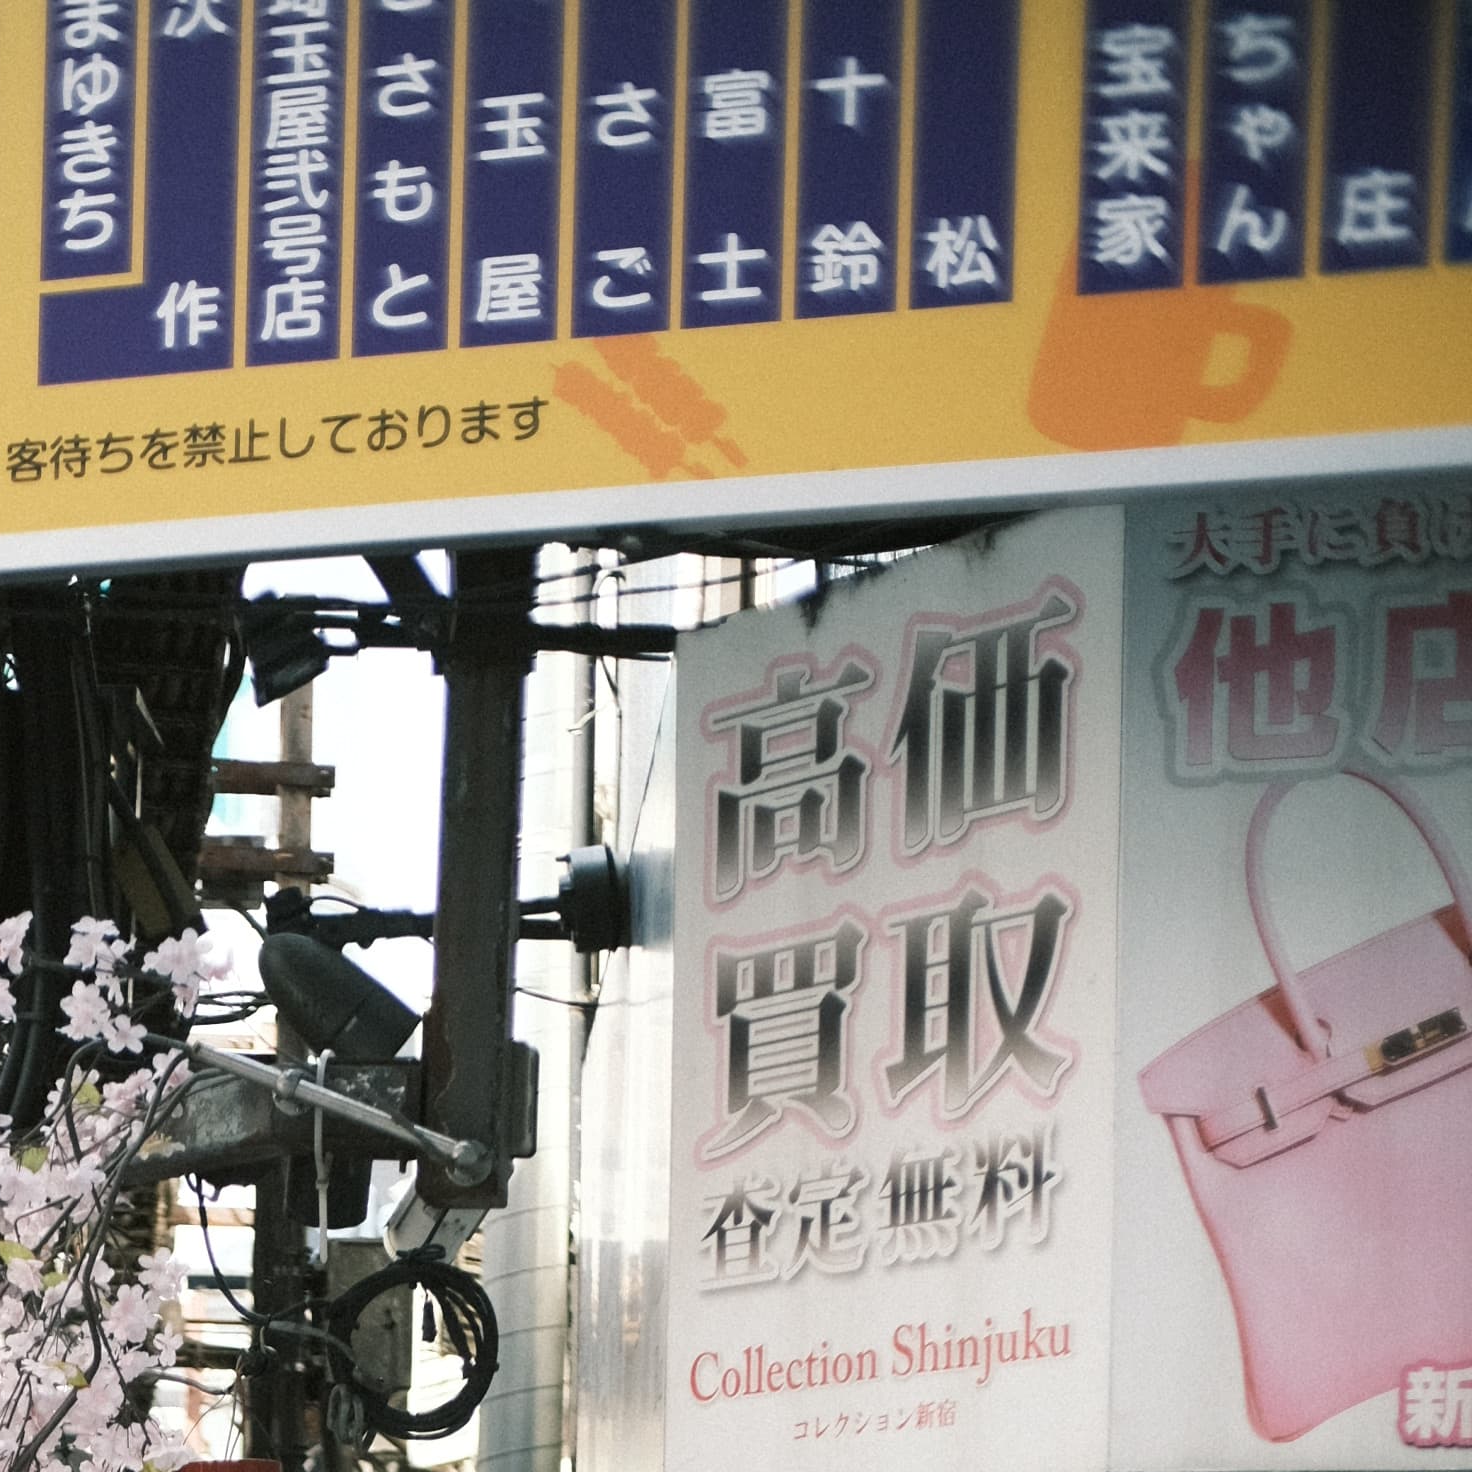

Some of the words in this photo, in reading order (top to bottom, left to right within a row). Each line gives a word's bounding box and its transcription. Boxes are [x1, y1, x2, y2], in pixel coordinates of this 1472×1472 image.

[259, 0, 331, 343] 玉屋弐号店
[371, 0, 436, 328] さもと
[477, 93, 546, 322] 玉屋
[592, 82, 658, 308] さご
[698, 69, 772, 302] 富士
[810, 56, 888, 293] 十鈴
[925, 214, 999, 289] 松
[1095, 23, 1176, 267] 宝来家
[1337, 168, 1415, 245] 庄
[713, 594, 1077, 900] 高価
[704, 887, 1077, 1151] 買取
[700, 1127, 1062, 1291] 査定無料
[689, 1341, 878, 1402] Collection
[890, 1308, 1073, 1386] Shinjuku
[792, 1397, 958, 1441] コレクション新宿
